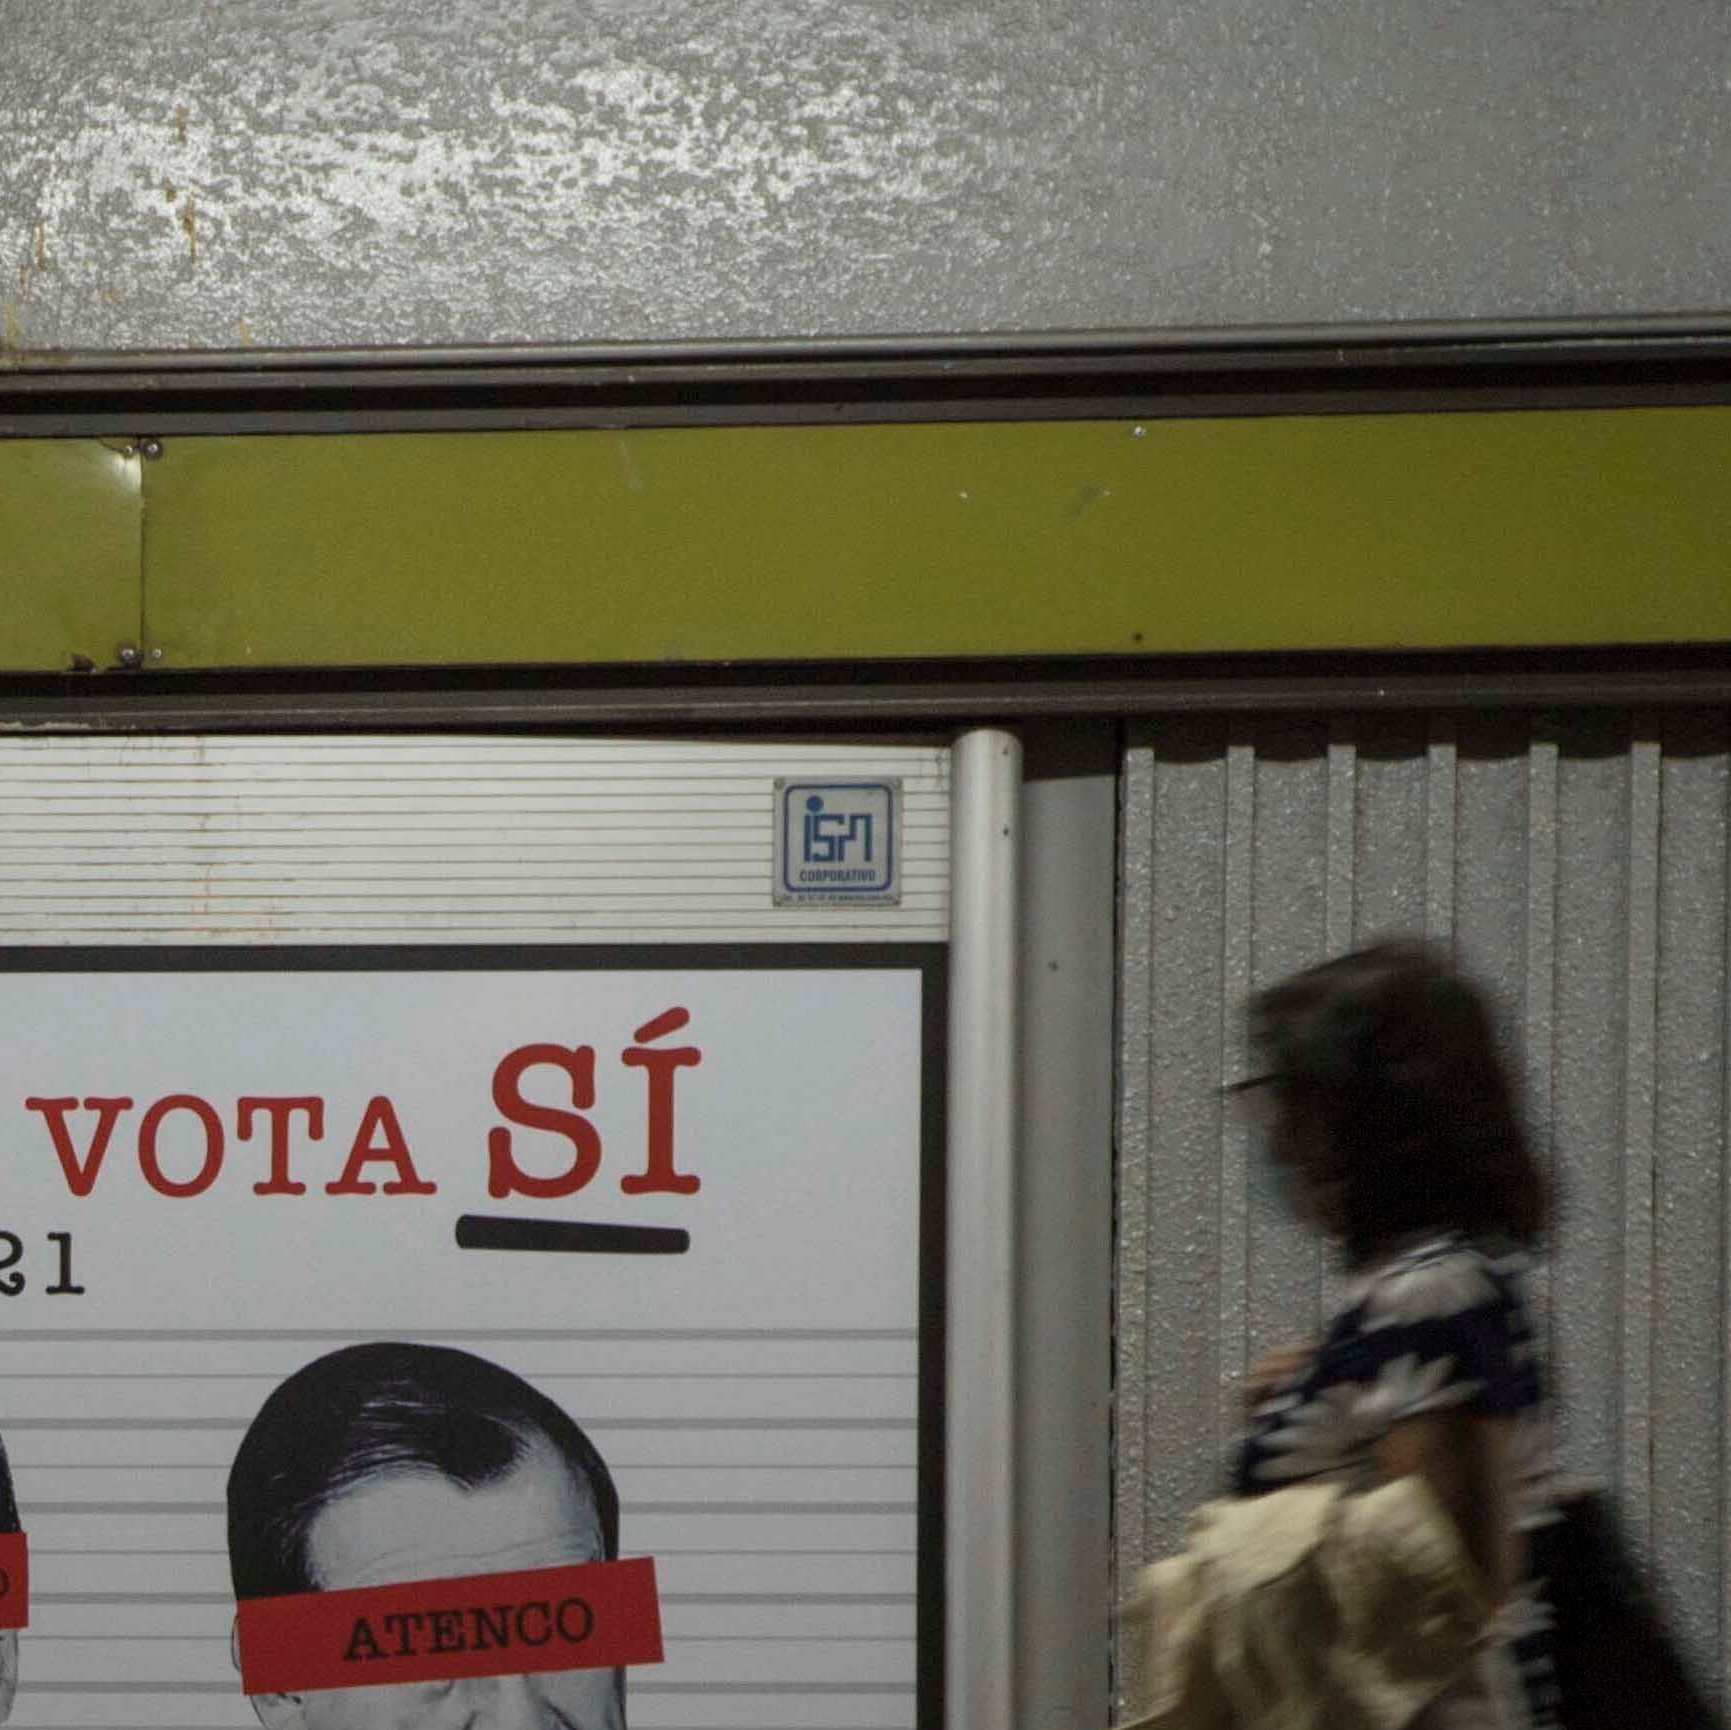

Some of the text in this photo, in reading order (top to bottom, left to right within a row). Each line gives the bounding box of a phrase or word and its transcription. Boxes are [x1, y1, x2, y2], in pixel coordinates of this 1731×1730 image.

[799, 869, 876, 883] CORPORATIVO
[23, 1094, 437, 1198] VOTA
[487, 1007, 705, 1199] SÍ
[341, 1596, 595, 1662] ATENCO
